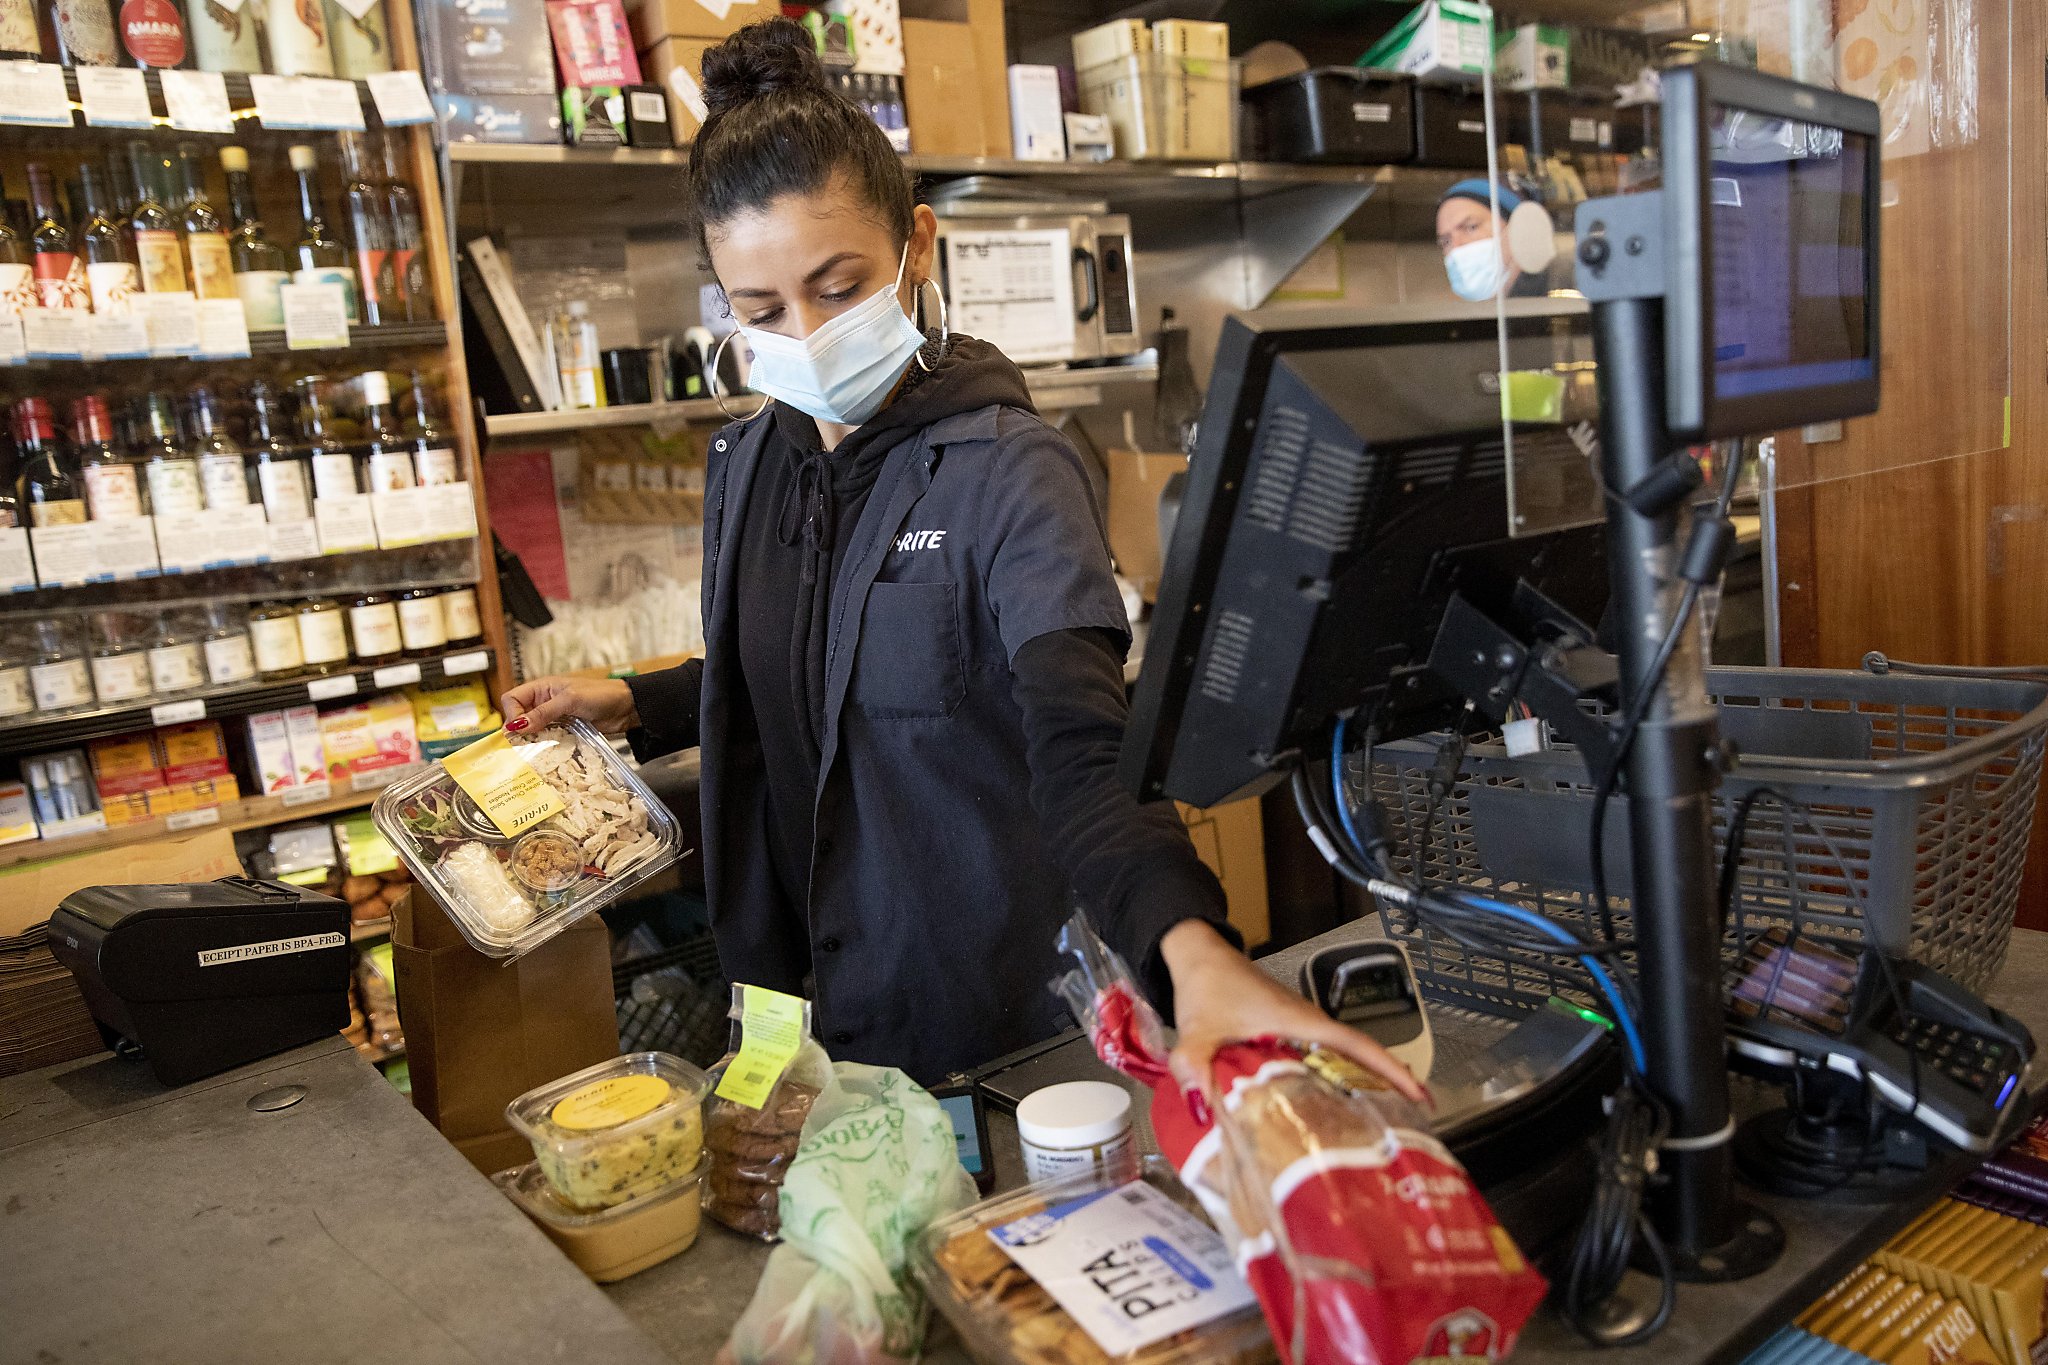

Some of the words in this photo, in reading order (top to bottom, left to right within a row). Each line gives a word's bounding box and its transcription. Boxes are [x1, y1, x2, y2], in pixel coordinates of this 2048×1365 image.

[127, 21, 182, 38] AMARA
[489, 791, 510, 805] Noodles
[505, 790, 526, 804] Chicken
[490, 801, 505, 812] Salad
[203, 949, 243, 963] ECEIPT
[245, 943, 279, 957] PAPER
[281, 941, 291, 951] IS
[1081, 1249, 1174, 1319] PITA
[1923, 1305, 1976, 1364] TCHO
